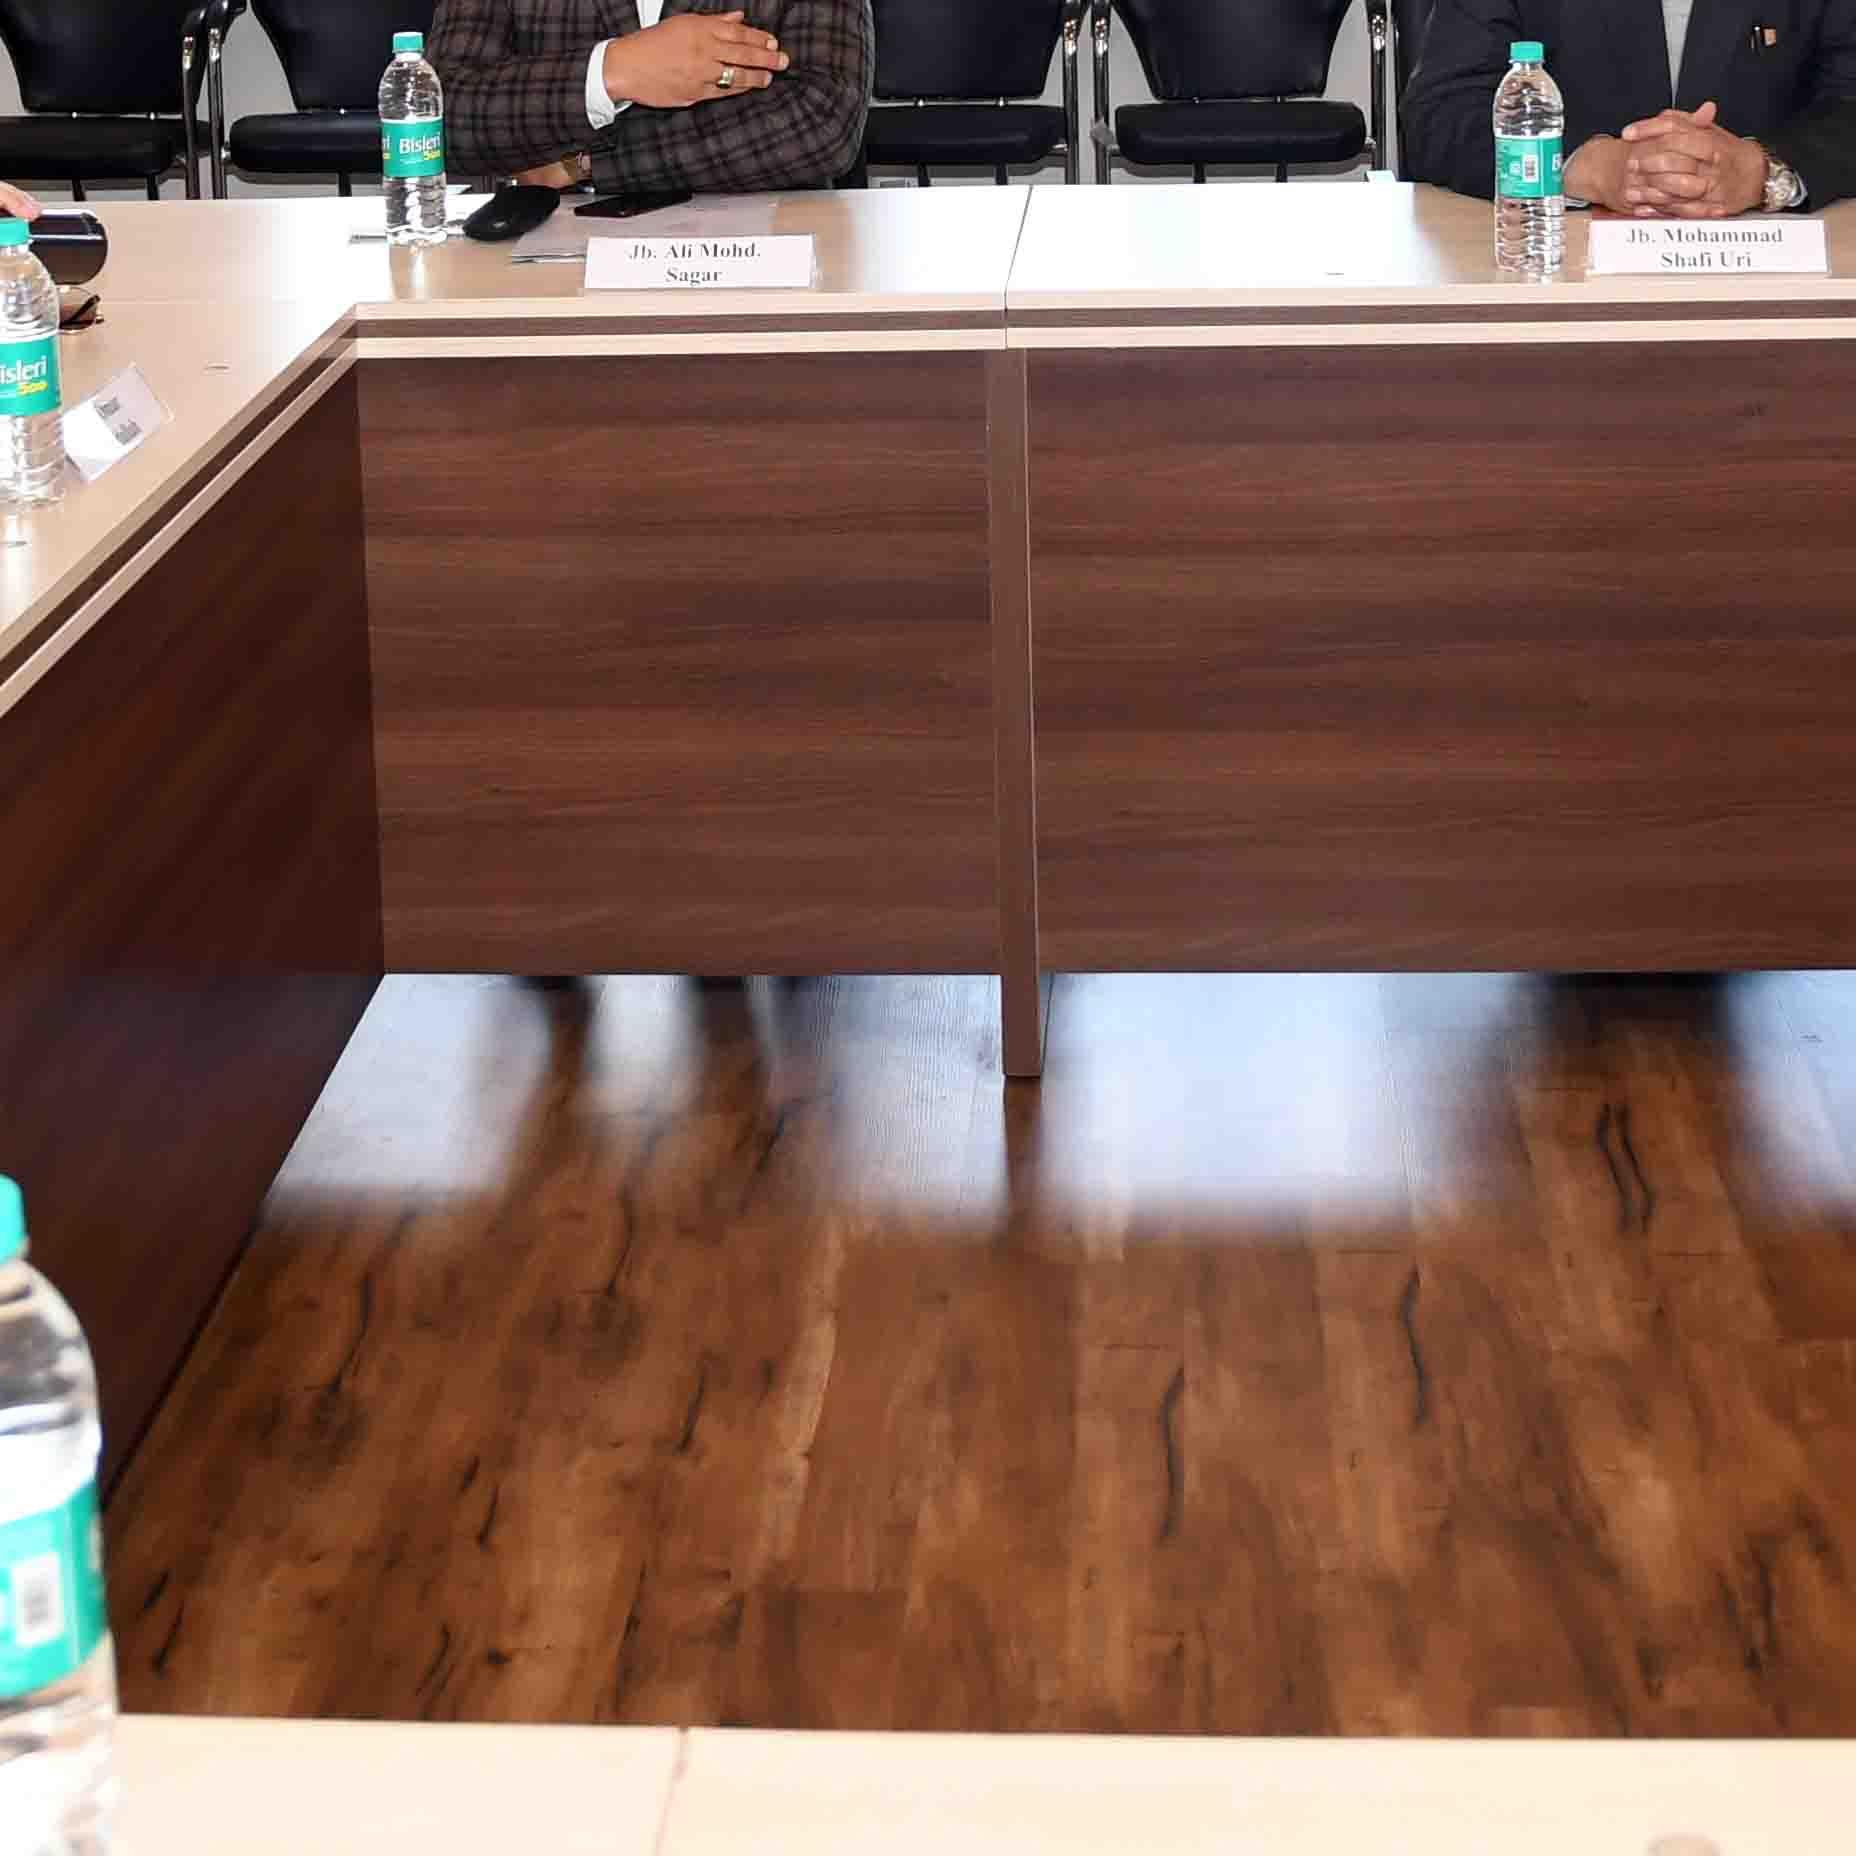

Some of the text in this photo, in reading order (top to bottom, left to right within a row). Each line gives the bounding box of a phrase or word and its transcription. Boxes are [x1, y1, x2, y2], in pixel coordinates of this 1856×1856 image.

[1626, 227, 1783, 243] Jb. Mohammad
[628, 242, 760, 259] Jb. Ali Mohd.
[1661, 251, 1751, 267] Shafi Uri
[665, 266, 723, 286] Sagar
